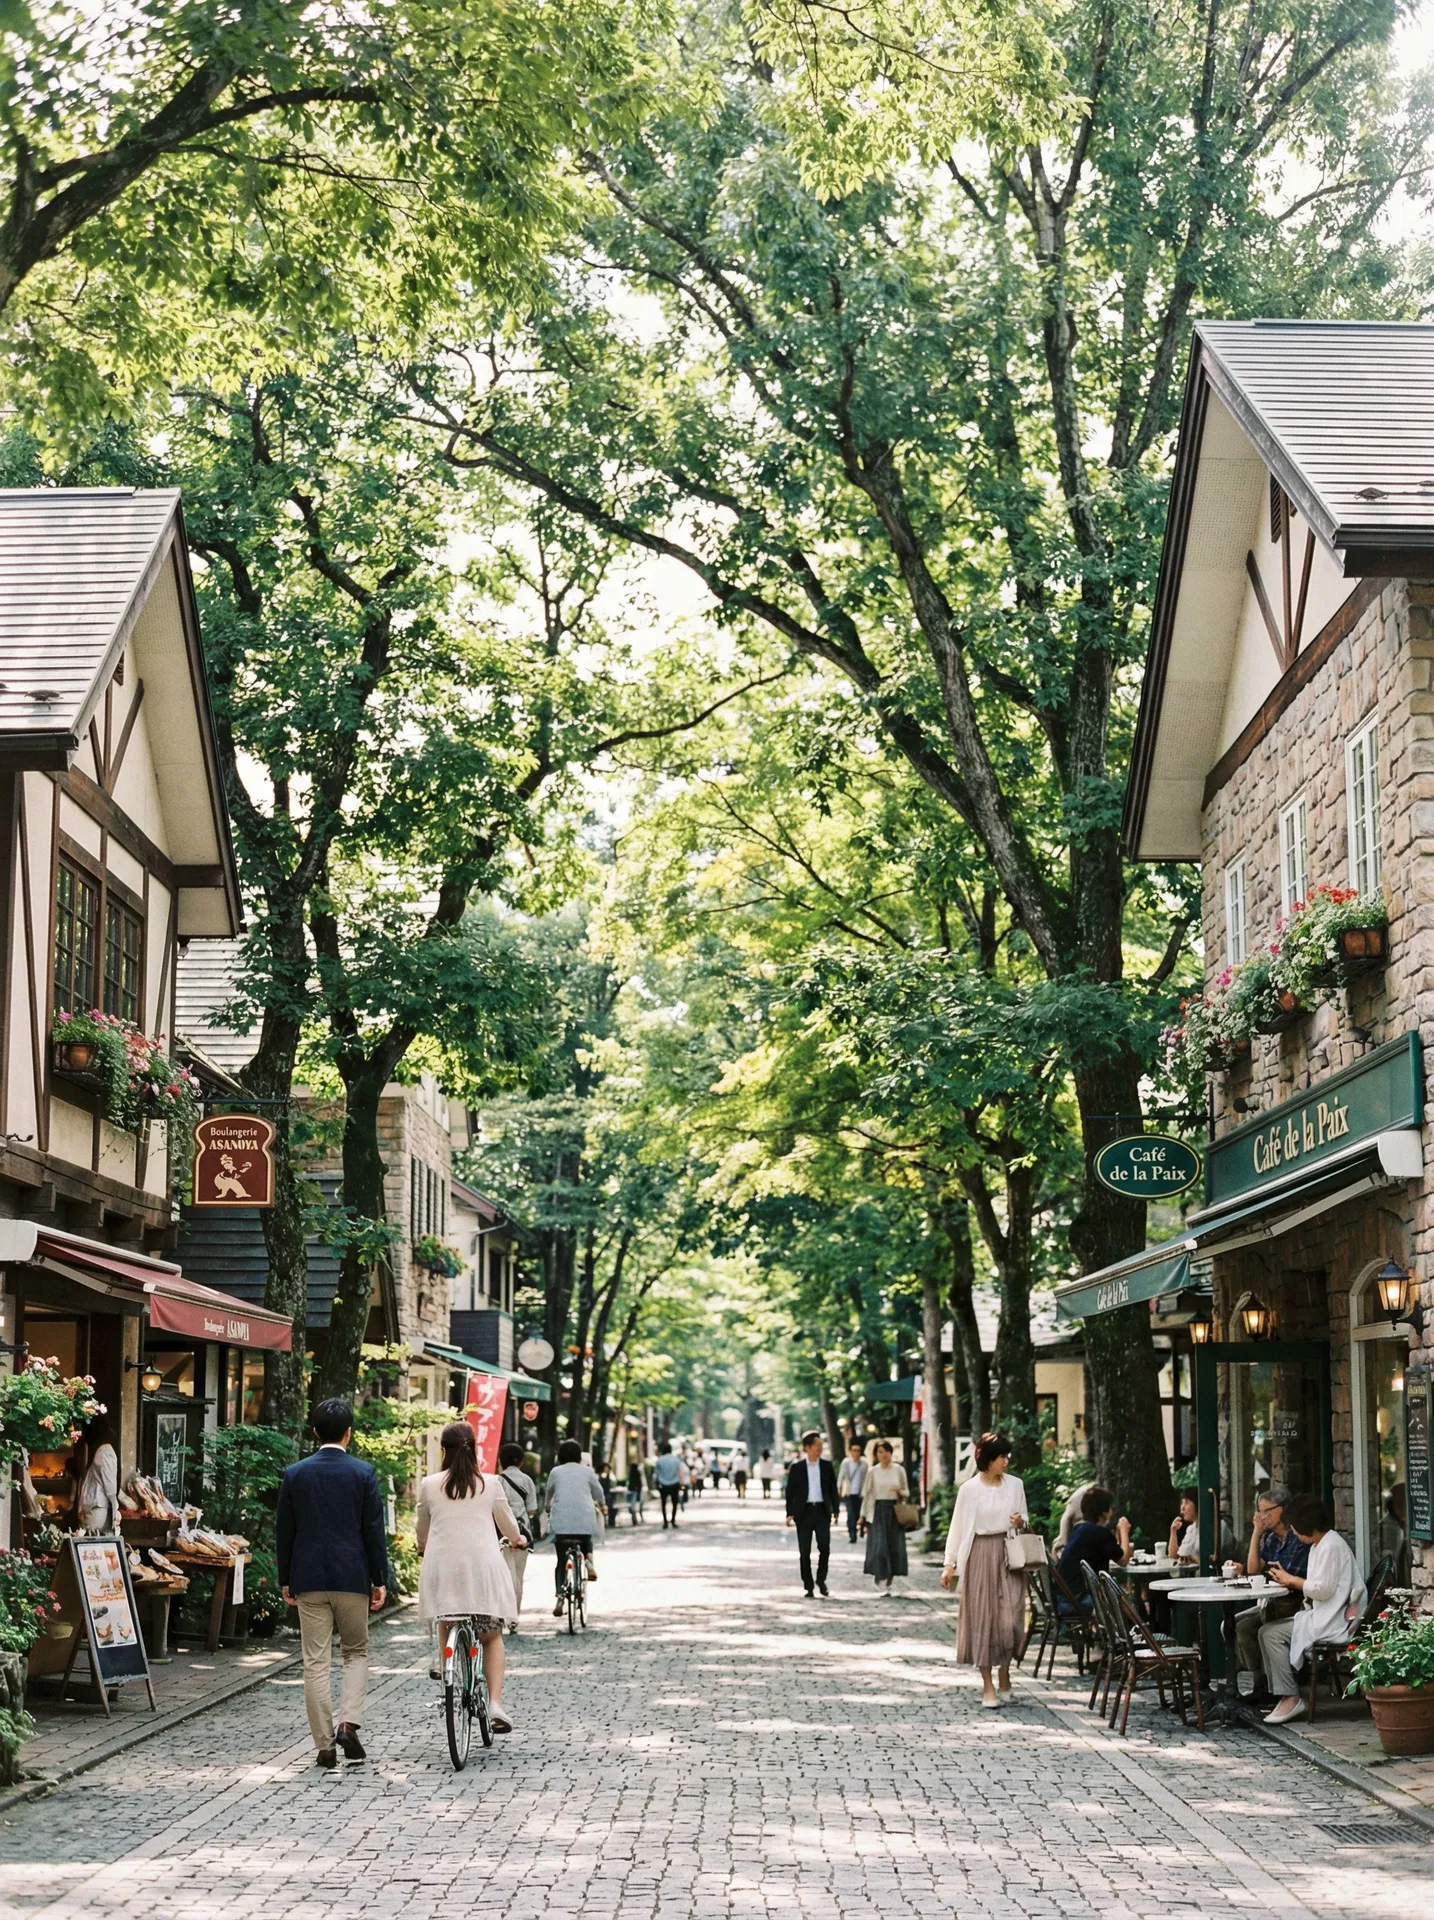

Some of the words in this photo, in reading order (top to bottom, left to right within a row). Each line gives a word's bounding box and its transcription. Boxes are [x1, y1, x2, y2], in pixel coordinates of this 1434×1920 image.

[210, 1126, 258, 1139] Boulangerie
[1253, 1126, 1282, 1174] Café
[1284, 1117, 1300, 1161] de
[1302, 1109, 1316, 1153] la
[1317, 1096, 1350, 1146] Paix
[209, 1139, 259, 1151] ASANOYA
[1128, 1146, 1167, 1162] Café
[1109, 1165, 1129, 1181] de
[1132, 1165, 1148, 1181] la
[1151, 1165, 1187, 1181] Paix
